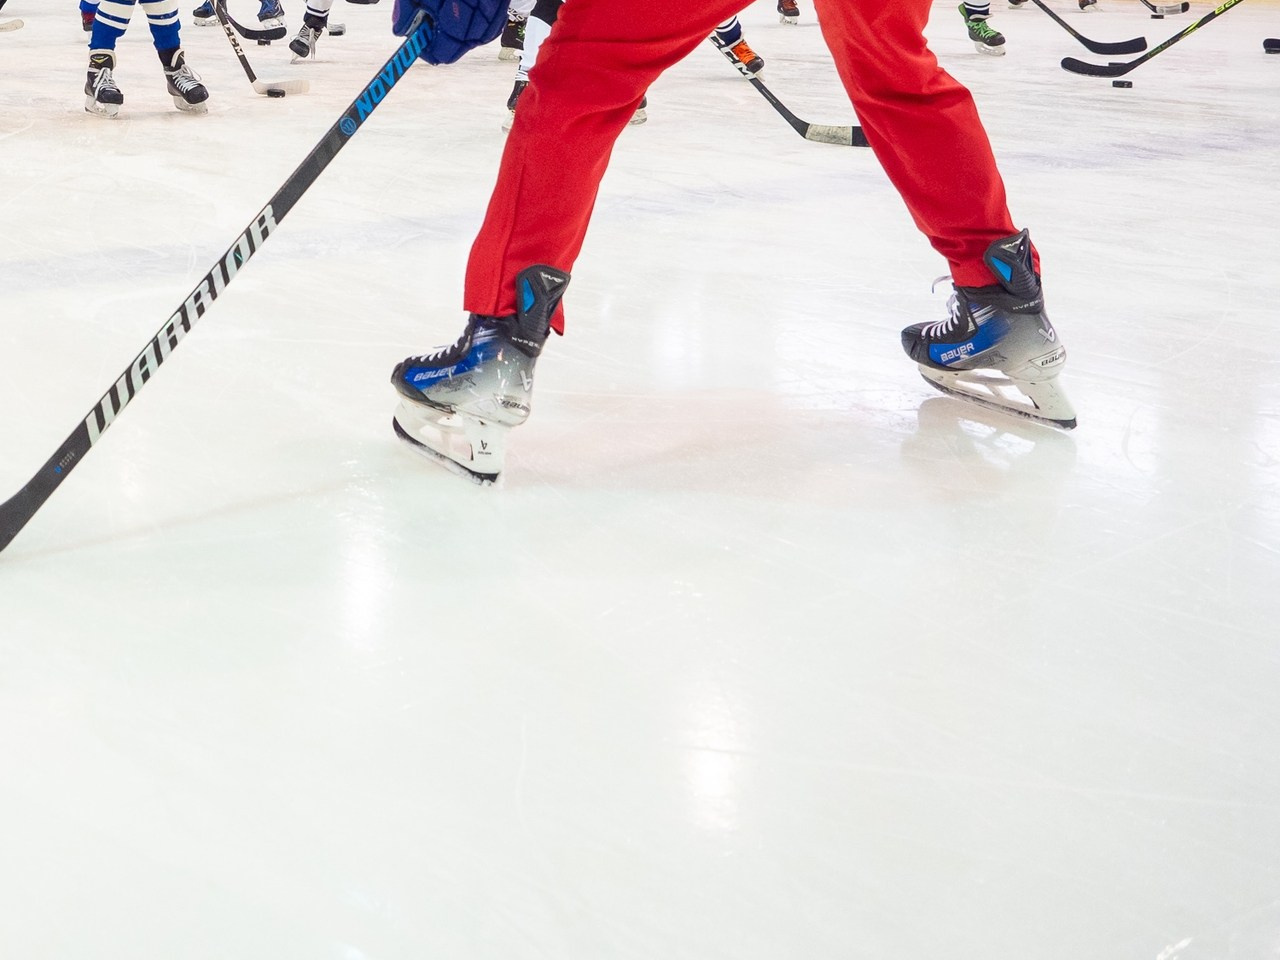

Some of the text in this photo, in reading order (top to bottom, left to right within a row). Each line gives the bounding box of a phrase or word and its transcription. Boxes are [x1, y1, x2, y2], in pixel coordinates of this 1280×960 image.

[83, 203, 279, 448] WARRIOR
[940, 342, 975, 362] BAUER
[413, 365, 457, 382] BAUER
